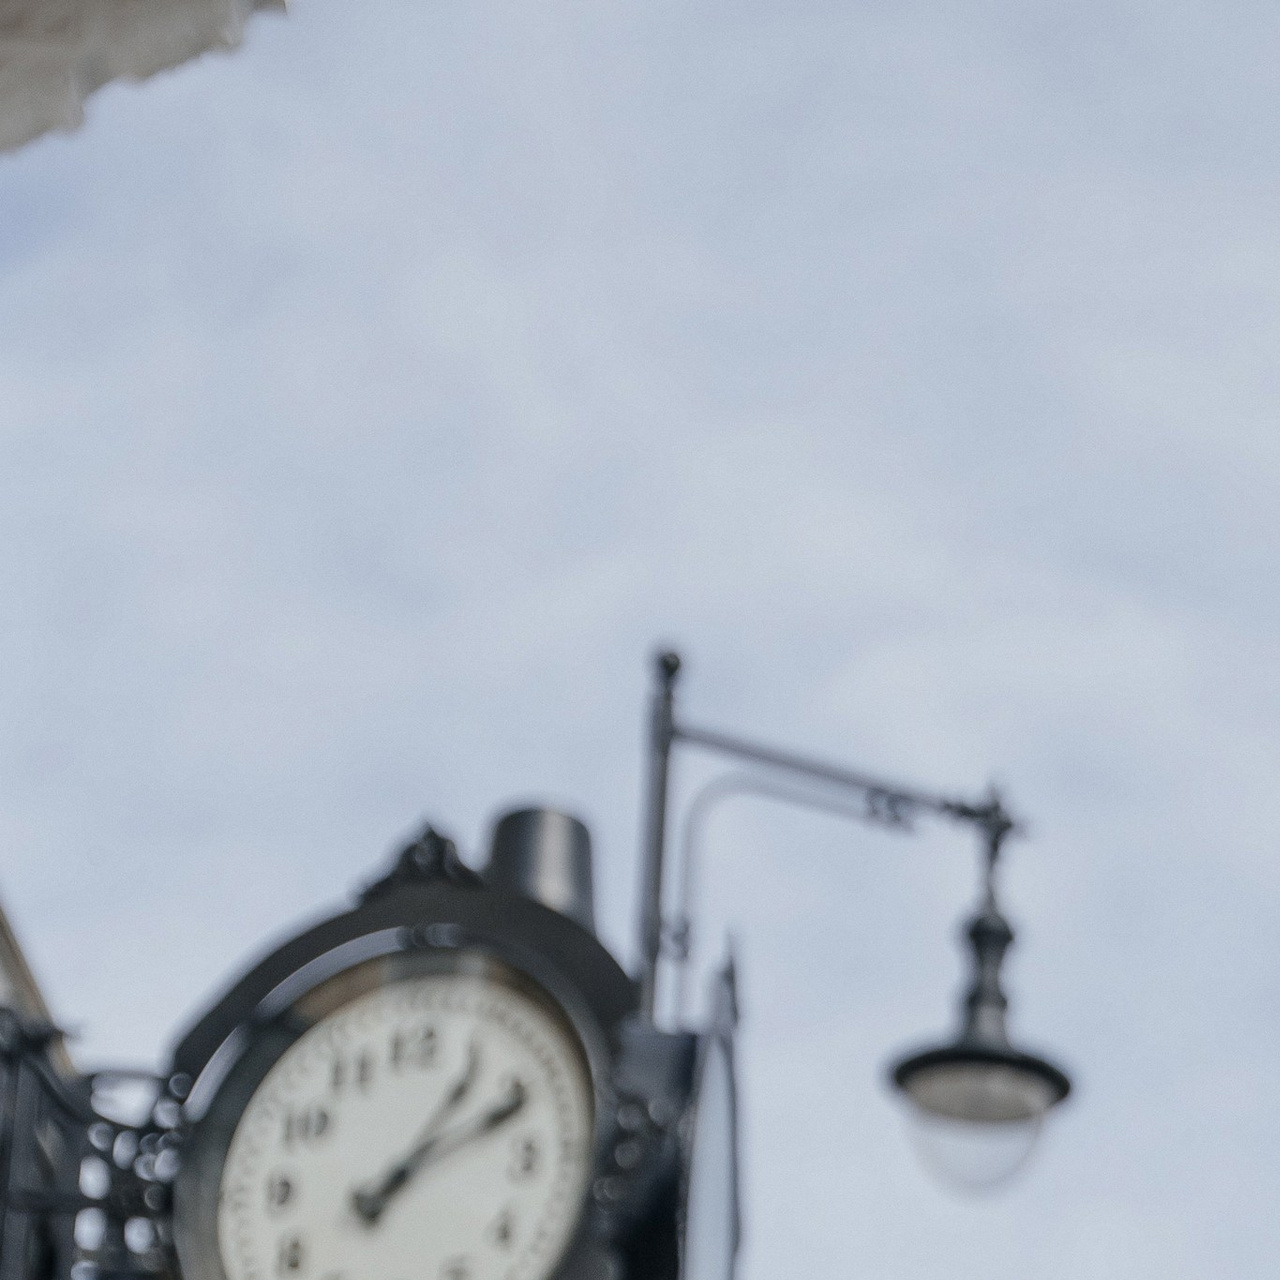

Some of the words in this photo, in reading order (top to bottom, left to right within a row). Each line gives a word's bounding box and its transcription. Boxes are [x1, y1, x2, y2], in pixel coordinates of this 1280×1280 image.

[329, 1047, 374, 1094] 11
[390, 1024, 438, 1074] 12
[282, 1102, 332, 1150] 10
[265, 1169, 295, 1219] 9
